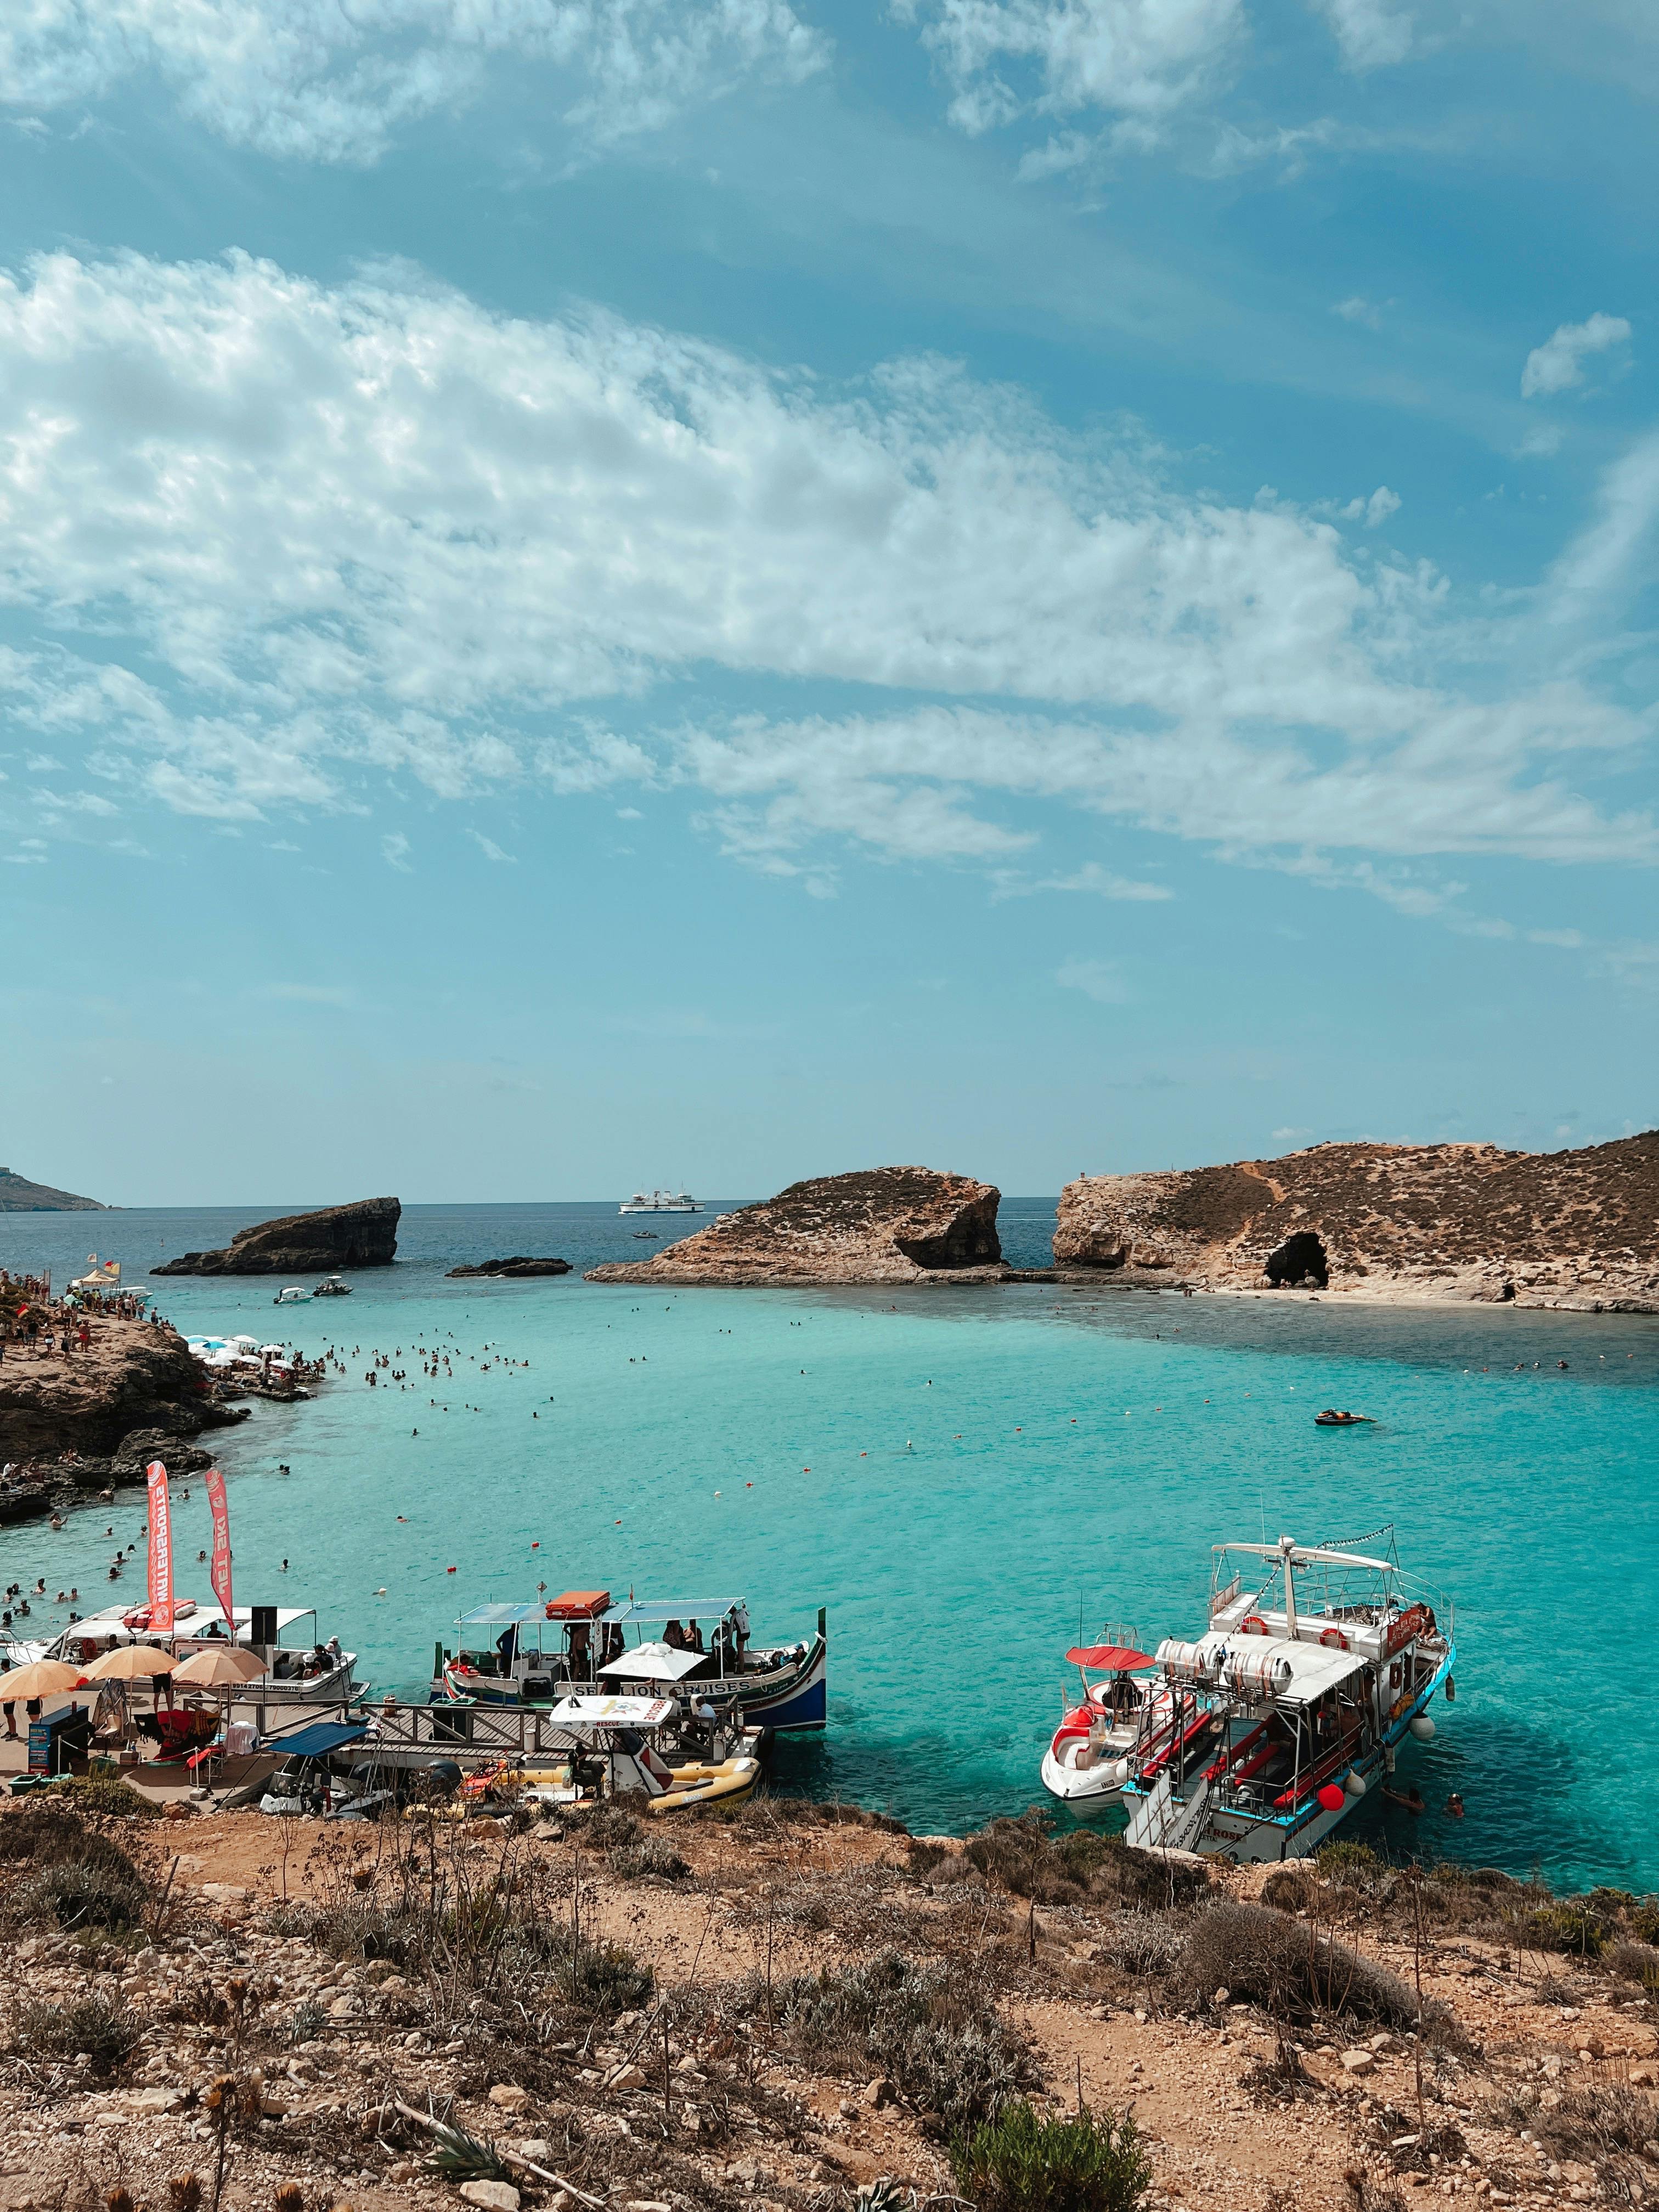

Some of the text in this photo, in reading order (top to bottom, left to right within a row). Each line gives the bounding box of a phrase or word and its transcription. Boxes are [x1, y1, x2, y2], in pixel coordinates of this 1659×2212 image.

[575, 1681, 750, 1696] SE LION CRUISES
[644, 1700, 667, 1720] RESCUE
[1214, 1829, 1244, 1840] ROSE
